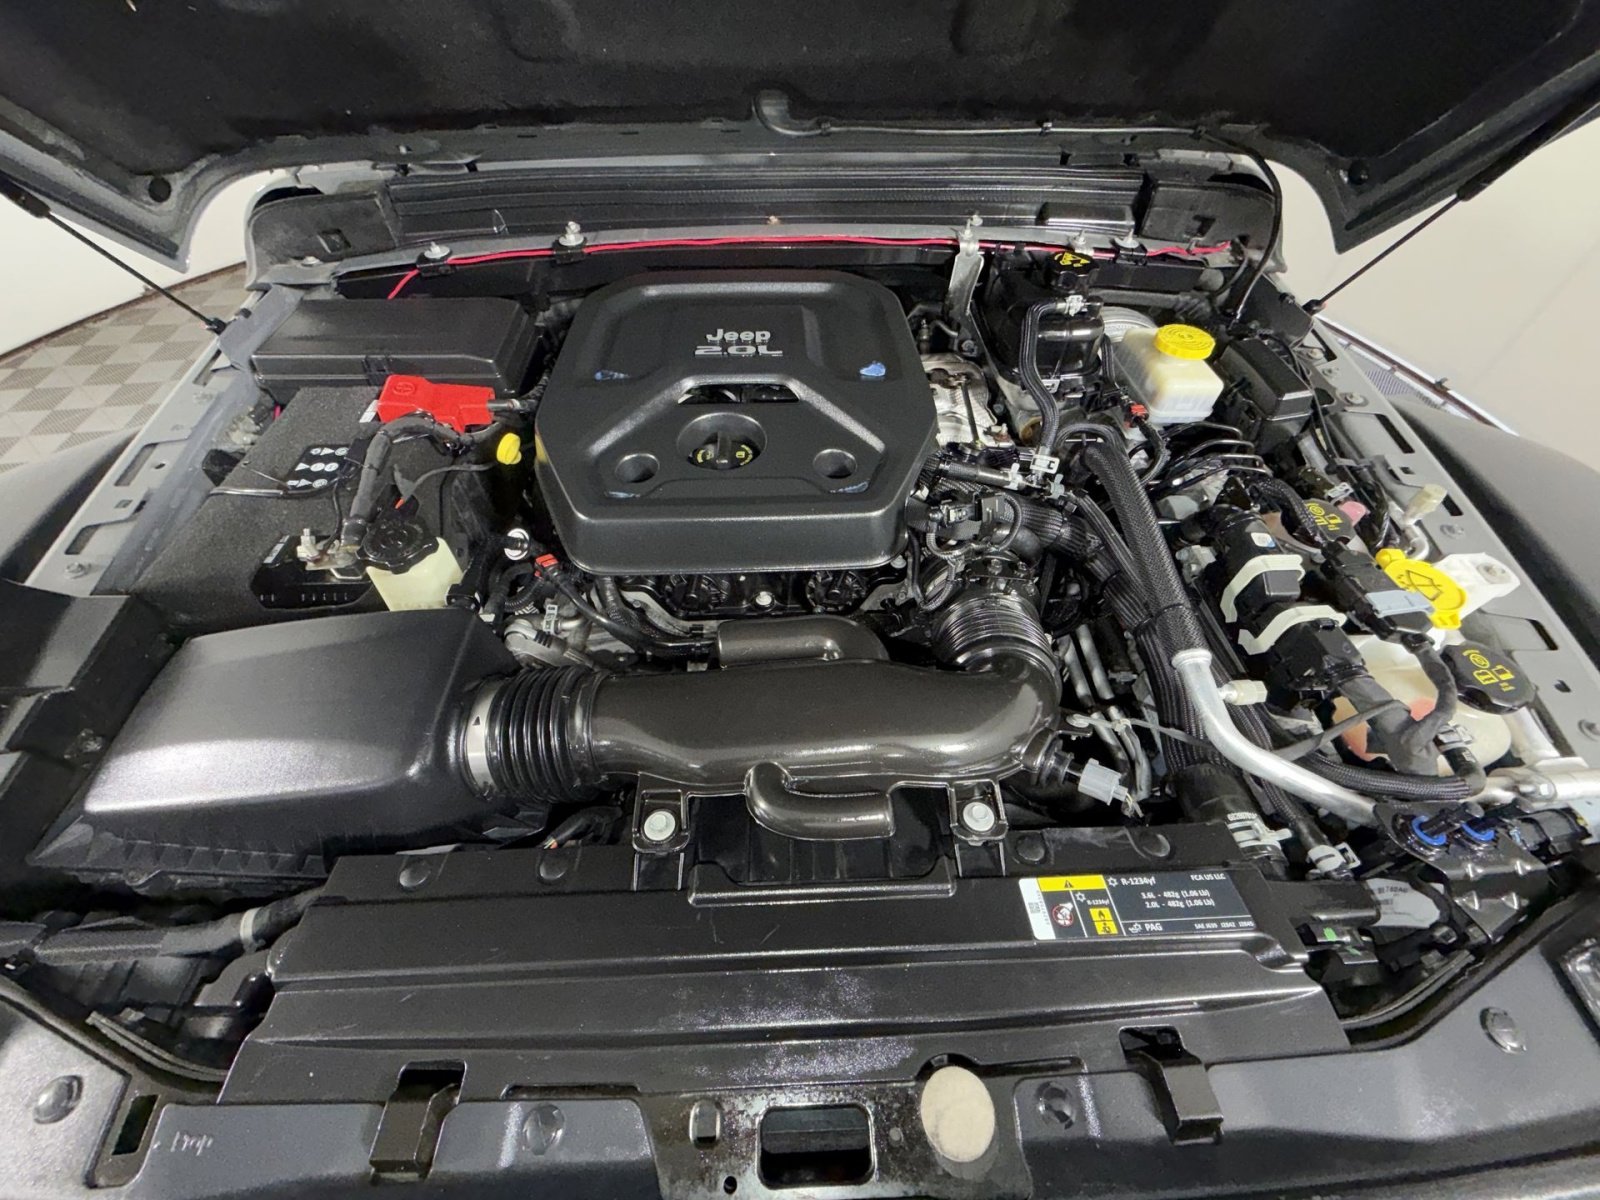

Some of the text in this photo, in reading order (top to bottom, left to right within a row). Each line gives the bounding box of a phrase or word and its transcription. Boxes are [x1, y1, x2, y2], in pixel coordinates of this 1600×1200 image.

[705, 328, 771, 345] Jeep
[694, 345, 783, 357] 2.0L
[1120, 876, 1156, 886] R-1234yf
[1203, 873, 1215, 881] US
[1213, 872, 1227, 880] LLC
[1140, 891, 1156, 899] 3.6L
[1145, 901, 1161, 909] 2.0L
[1144, 922, 1163, 932] PAG
